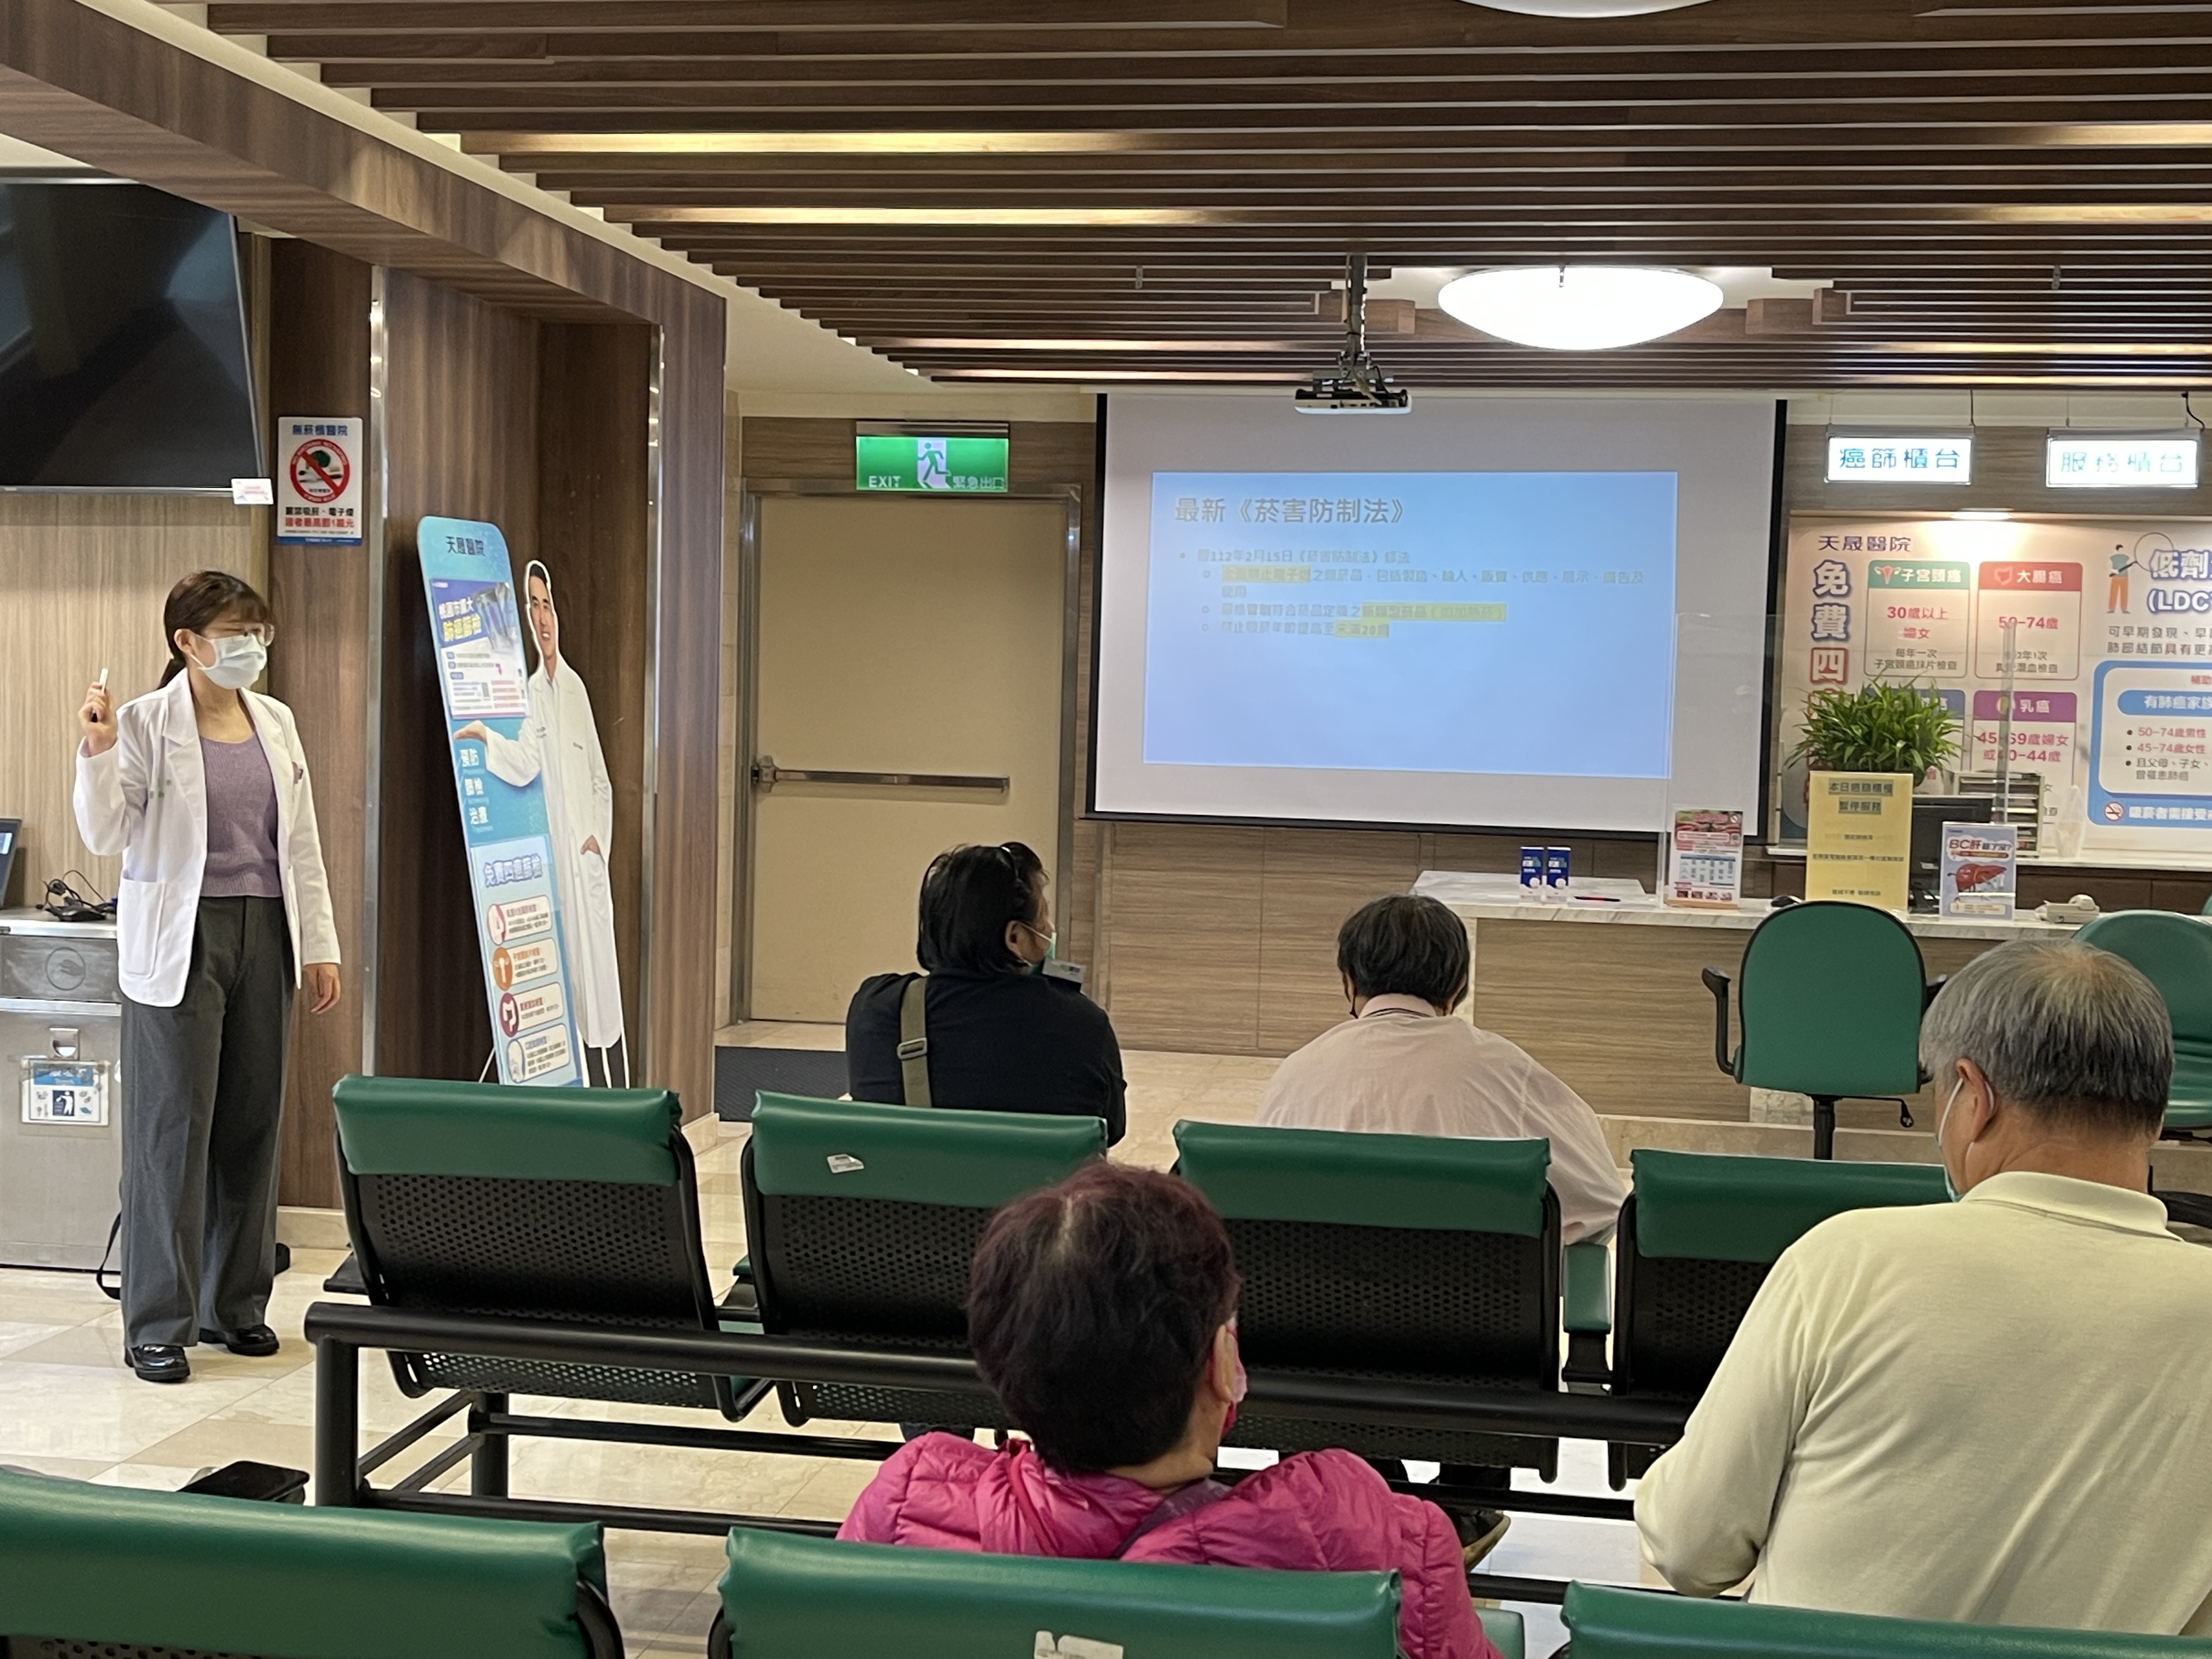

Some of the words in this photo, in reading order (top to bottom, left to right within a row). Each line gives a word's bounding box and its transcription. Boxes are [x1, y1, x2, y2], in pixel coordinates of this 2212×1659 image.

[1839, 448, 1961, 469] 癌篩櫃台
[2061, 452, 2184, 473] 服務櫃台
[868, 476, 901, 488] EXIT
[952, 476, 1005, 489] 緊急出口
[1175, 497, 1403, 523] 最新《菸害防制法》
[1818, 535, 1911, 552] 天晟醫院
[2149, 549, 2211, 580] 低劑
[1901, 568, 1961, 583] 子宮頸癌
[2017, 569, 2063, 584] 大腸癌
[2147, 589, 2211, 613] (LDC
[1887, 606, 1949, 619] 30歲以上
[1904, 628, 1930, 639] 婦女
[2108, 626, 2211, 639] 可早期發現、早
[1895, 648, 1938, 658] 每年一次
[2107, 642, 2211, 656] 肺部結節具有更
[2019, 699, 2050, 713] 乳癌
[2138, 727, 2207, 738] 50-74歲男性
[2137, 743, 2206, 754] 45-74歲女性
